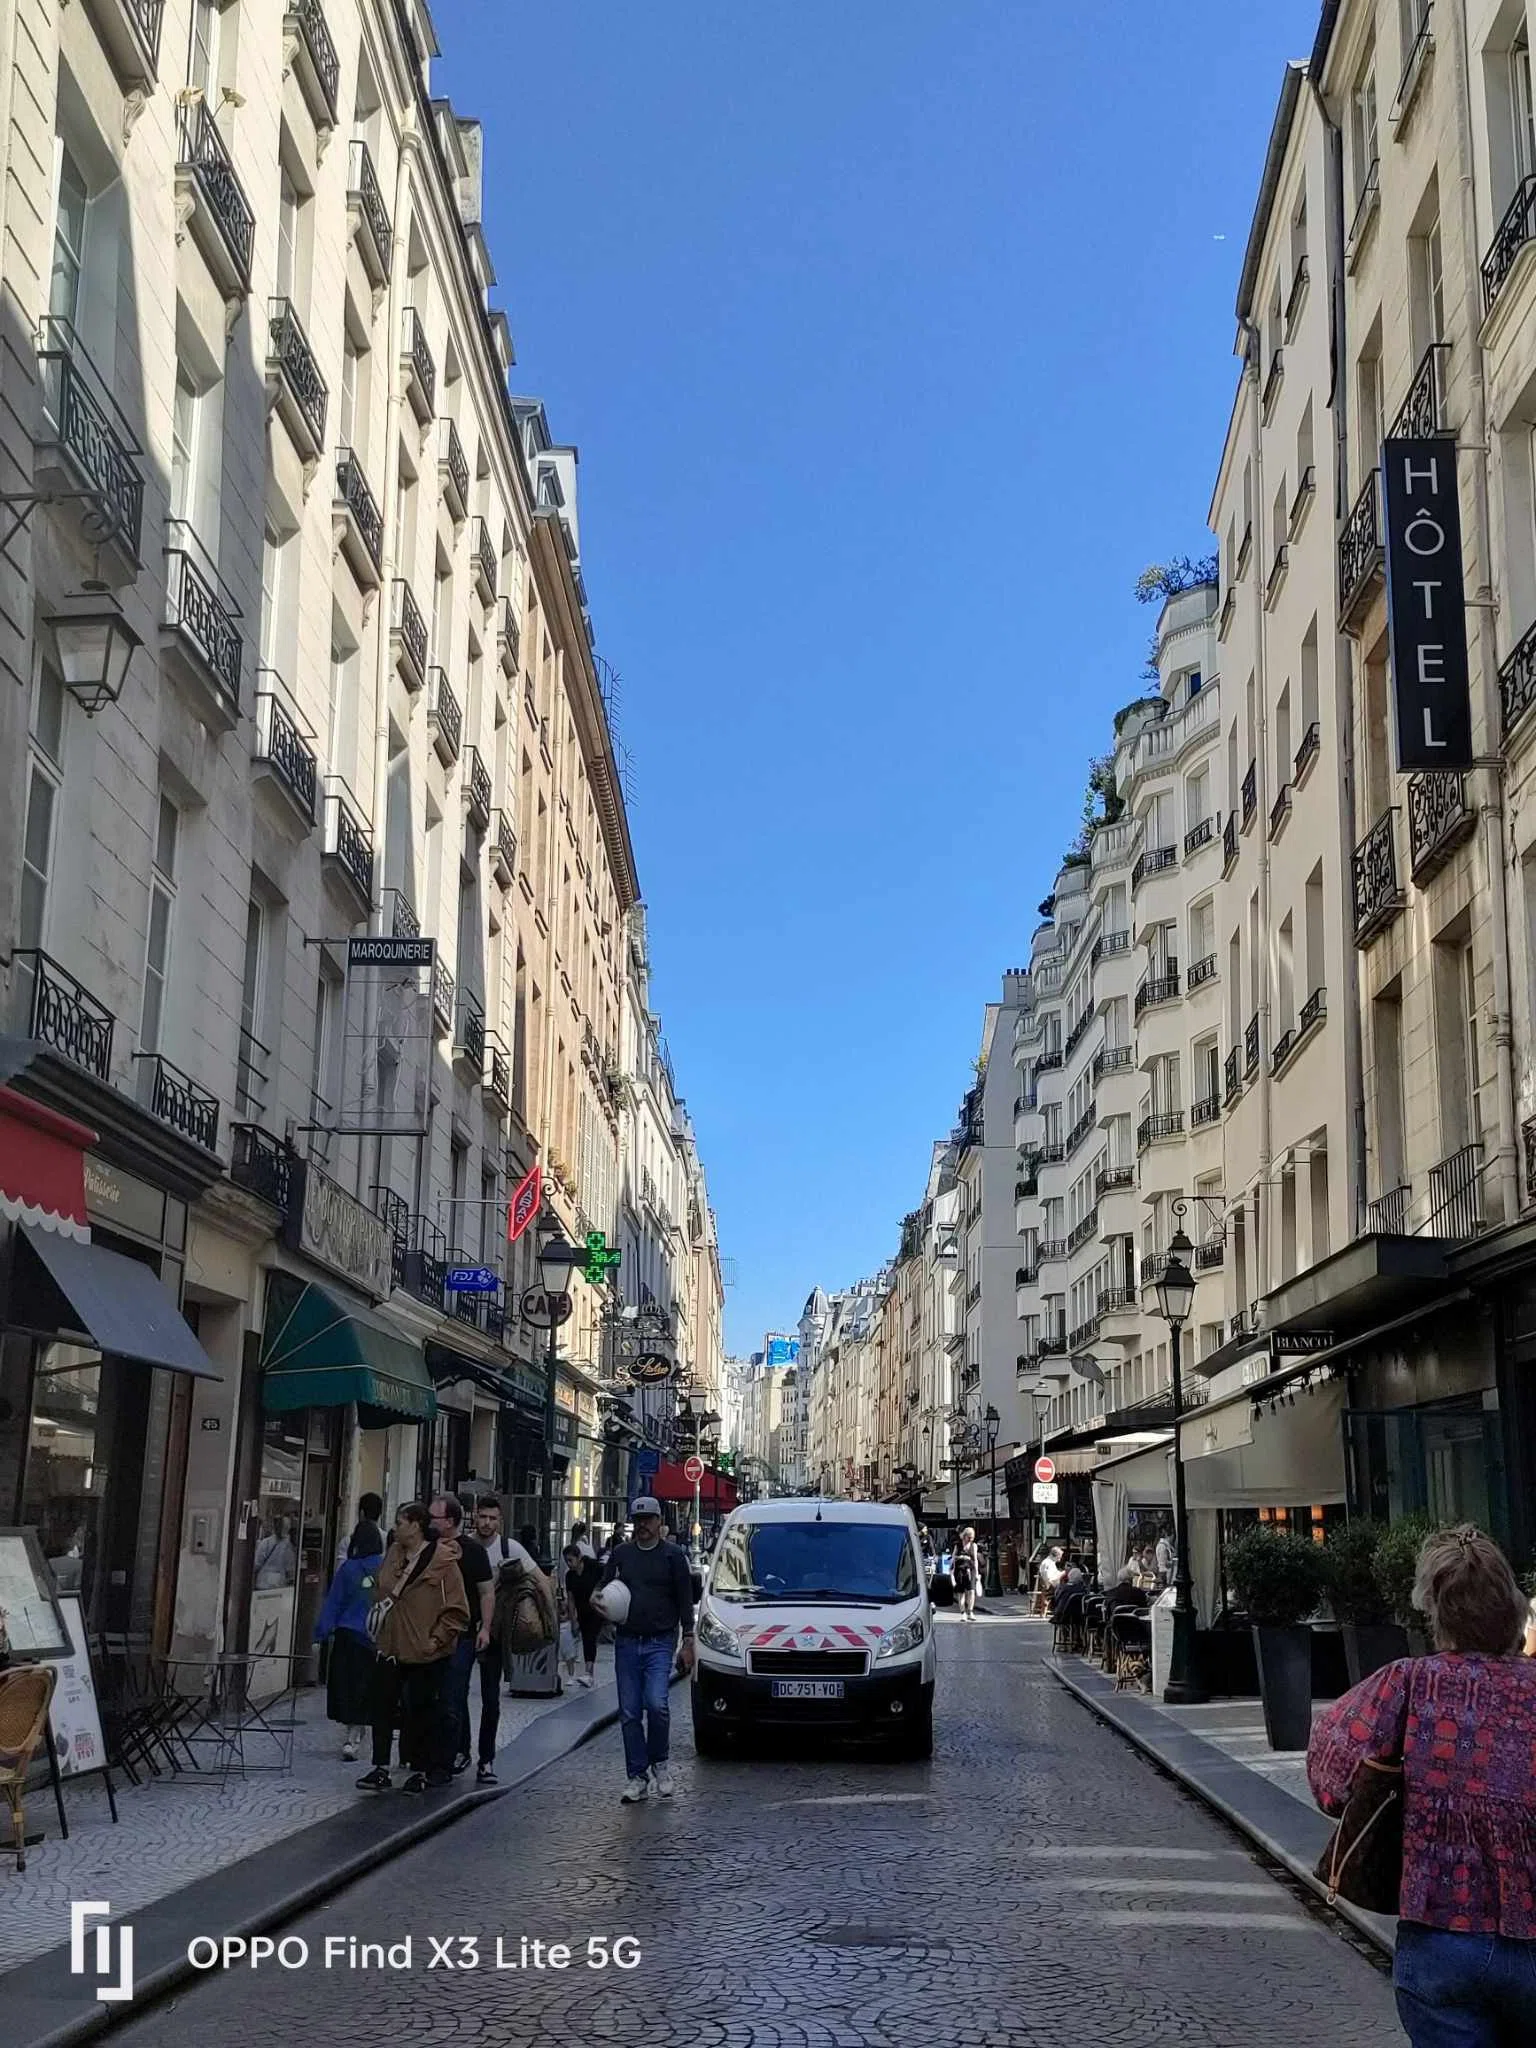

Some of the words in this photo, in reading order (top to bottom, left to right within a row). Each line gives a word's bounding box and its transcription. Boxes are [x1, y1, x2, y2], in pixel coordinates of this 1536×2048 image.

[1404, 457, 1447, 747] HÔTEL
[351, 943, 430, 960] MAROQUINERIE
[515, 1181, 536, 1225] TABAC
[452, 1271, 474, 1281] FDJ
